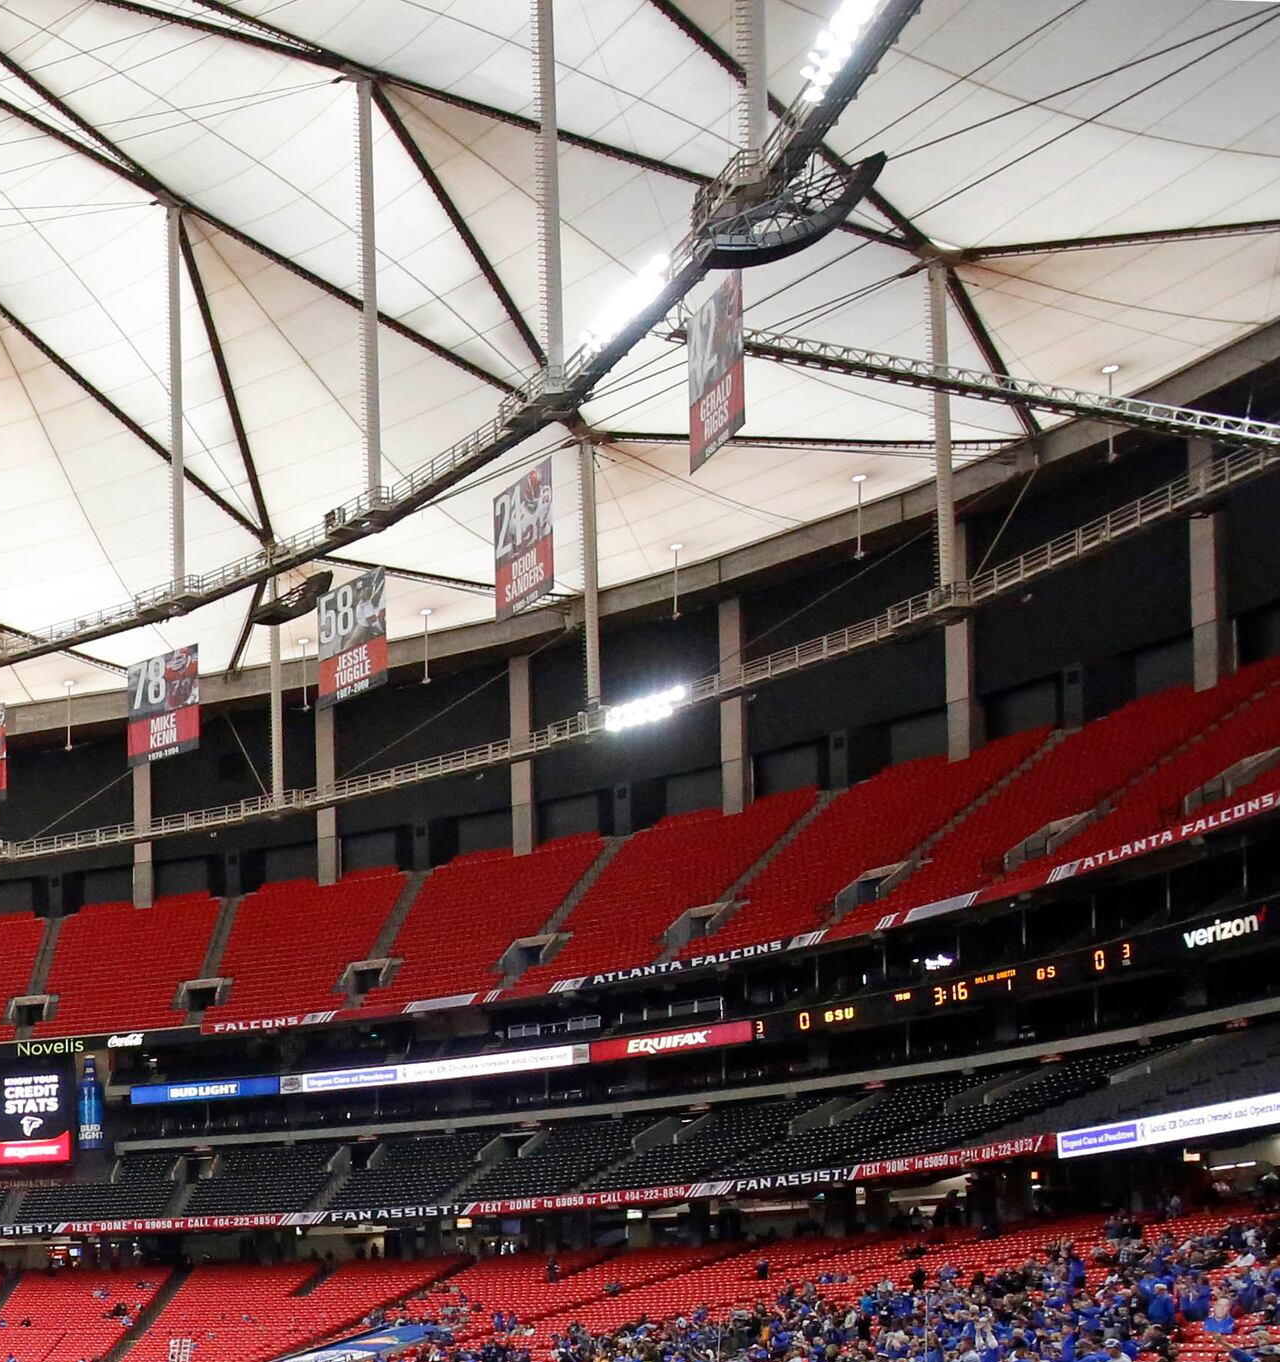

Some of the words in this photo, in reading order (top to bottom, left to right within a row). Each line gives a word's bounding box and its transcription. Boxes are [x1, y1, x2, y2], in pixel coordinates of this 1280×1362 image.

[700, 374, 732, 422] GERALD
[704, 399, 729, 441] RIGGS
[511, 548, 536, 579] DEION
[505, 562, 544, 602] SANDERS
[320, 584, 354, 645] 58
[337, 644, 368, 672] JESSIE
[131, 656, 166, 711] 78
[334, 659, 371, 689] TUGGLE
[150, 713, 176, 735] MIKE
[149, 729, 177, 749] KENN
[1082, 831, 1173, 869] ATLANTA
[1181, 793, 1274, 837] FALCONS
[1183, 914, 1259, 948] verizon
[593, 961, 683, 985] ATLANTA
[691, 940, 782, 967] FALCONS
[756, 1021, 764, 1033] 3
[799, 1012, 810, 1030] 0
[824, 1007, 854, 1023] GSU
[933, 981, 968, 1006] 3:16
[1036, 965, 1056, 980] GS
[1094, 950, 1105, 971] 0
[1122, 943, 1130, 959] 3
[213, 1016, 299, 1033] FALCONS
[17, 1039, 84, 1056] Novelis
[626, 1030, 710, 1054] EQUIFAX
[4, 1077, 33, 1086] KNOW
[33, 1074, 59, 1084] YOUR
[4, 1084, 59, 1099] CREDIT
[169, 1087, 198, 1099] BUD
[198, 1083, 238, 1096] LIGHT
[5, 1097, 59, 1113] STATS
[80, 1124, 102, 1132] BUD
[1150, 1121, 1167, 1133] Local
[1179, 1116, 1205, 1128] Doctors
[1234, 1108, 1248, 1119] and
[736, 1177, 771, 1192] FAN
[775, 1168, 847, 1188] ASSIST!
[862, 1161, 881, 1176] TEXT
[331, 1210, 372, 1221] FAN
[377, 1204, 459, 1218] ASSIST!
[479, 1202, 502, 1213] TEXT
[555, 1195, 584, 1206] 69050
[600, 1193, 623, 1204] CALL
[71, 1221, 93, 1231] TEXT
[187, 1217, 210, 1228] CALL
